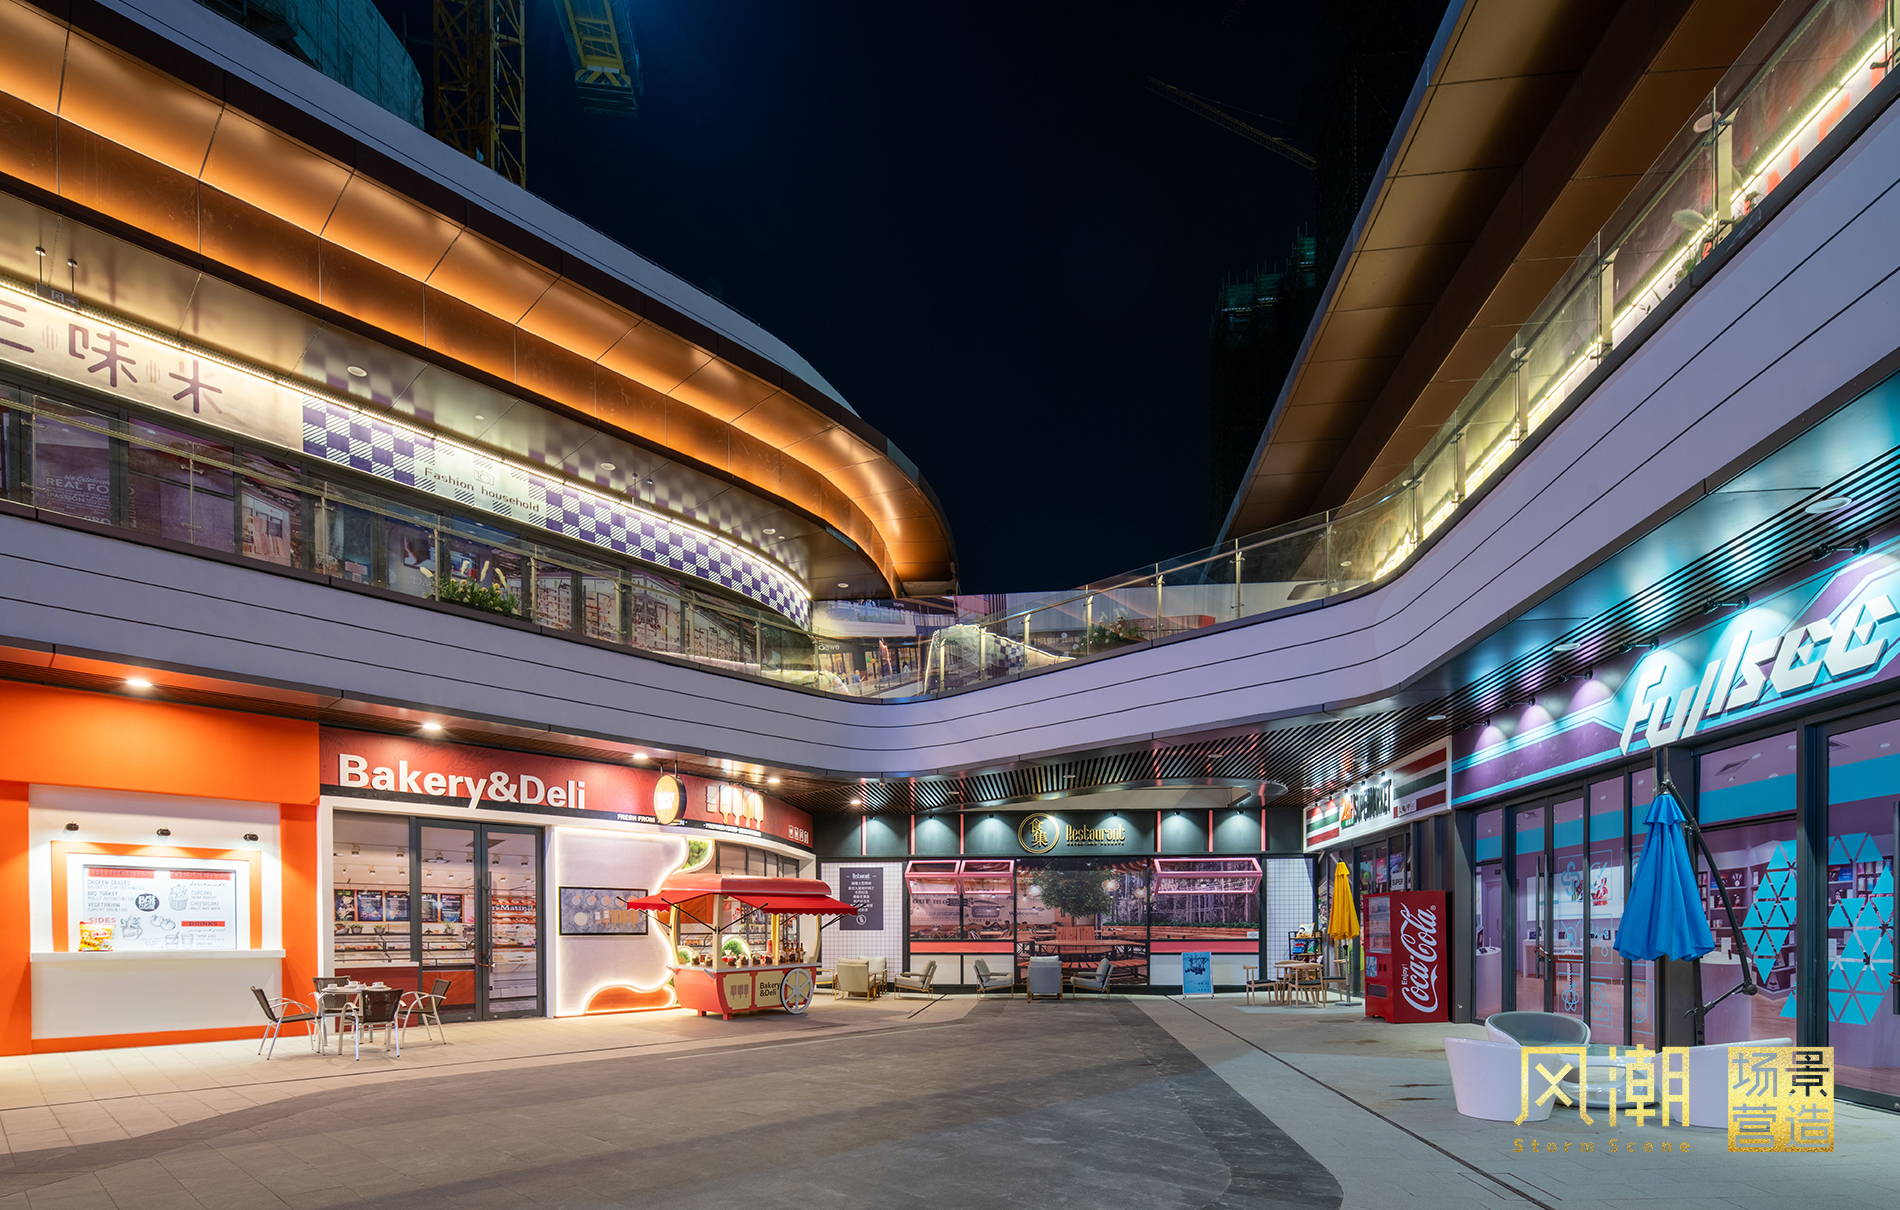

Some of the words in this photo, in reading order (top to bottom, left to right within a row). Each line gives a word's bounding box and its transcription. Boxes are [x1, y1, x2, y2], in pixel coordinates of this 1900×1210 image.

[46, 478, 83, 491] REAL
[424, 467, 475, 492] Fashion
[481, 486, 540, 512] household
[338, 753, 586, 810] Bakery&Deli
[617, 813, 637, 822] FRESH
[1065, 823, 1126, 842] Restaurant
[94, 869, 150, 878] BURGERS
[172, 871, 229, 879] DESSERTS
[1391, 878, 1404, 887] SUPER
[88, 916, 117, 924] SIDES
[1400, 902, 1439, 1013] Coca-Cola
[759, 982, 780, 991] Bakery
[759, 989, 777, 997] &Deli
